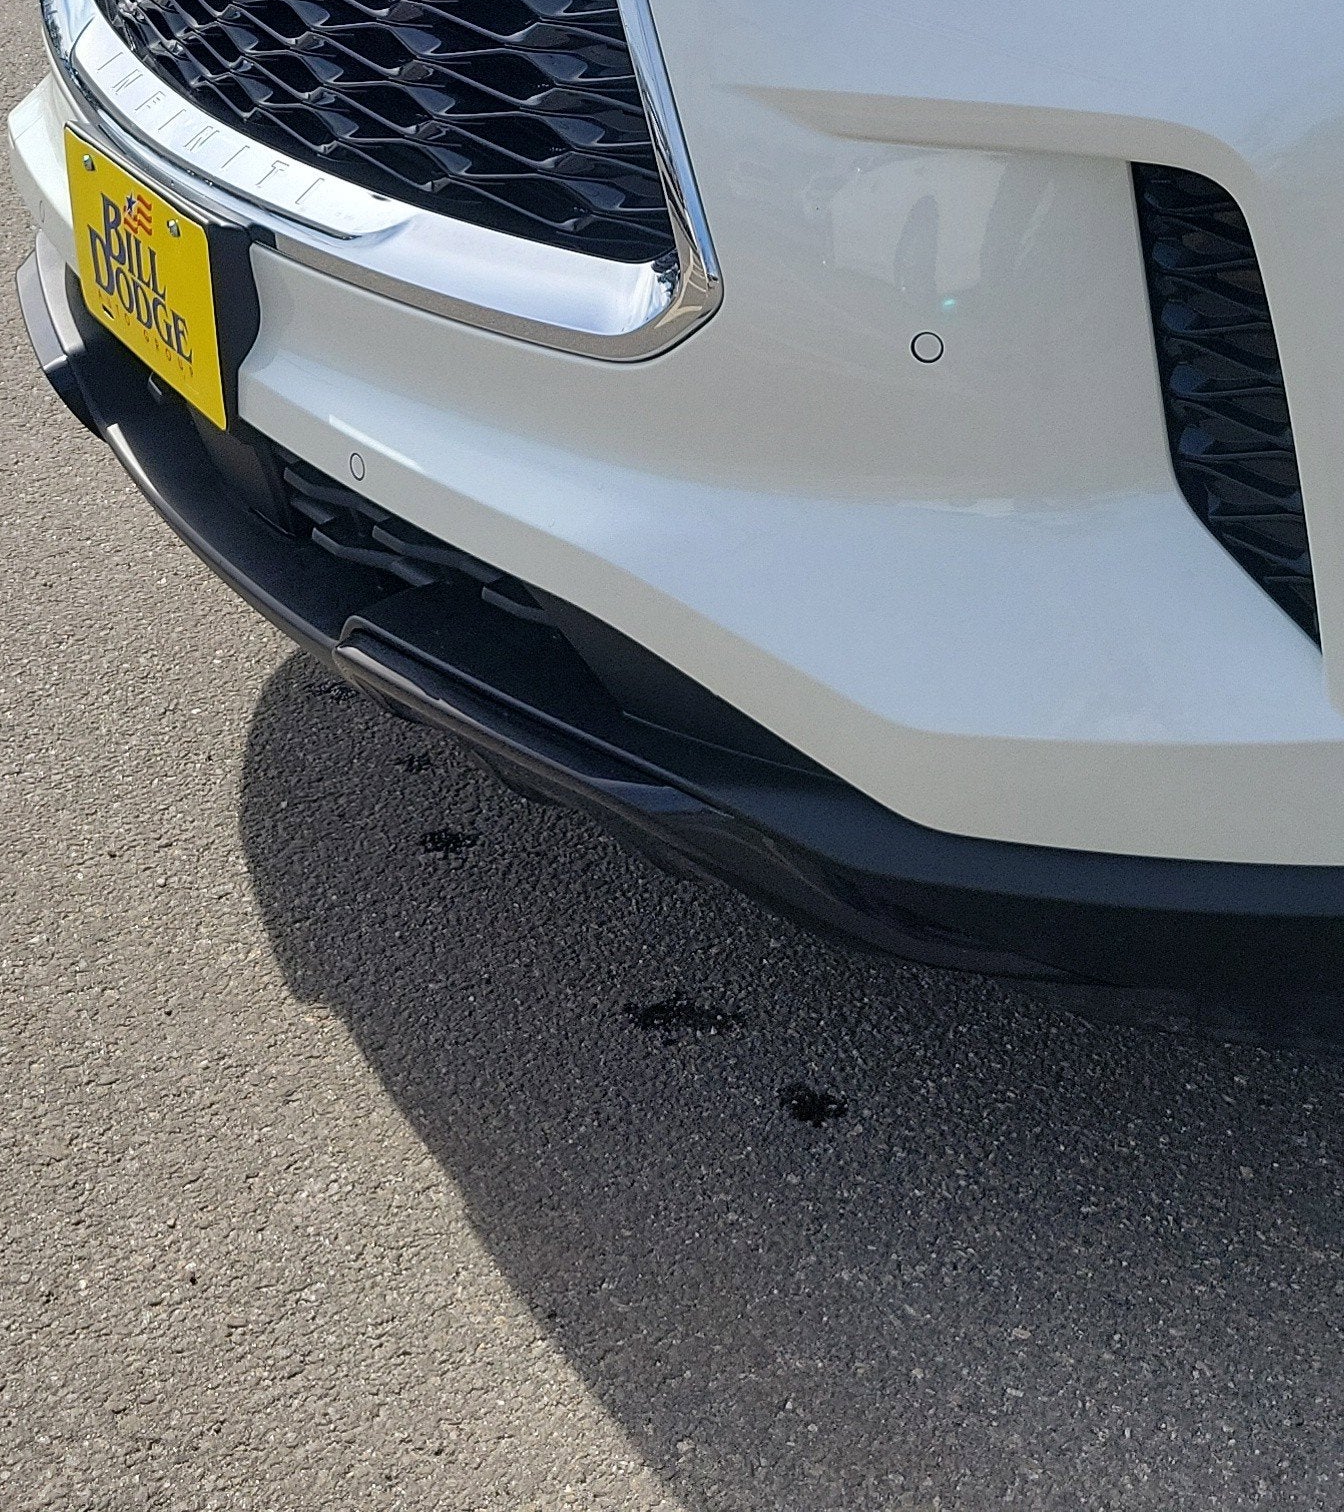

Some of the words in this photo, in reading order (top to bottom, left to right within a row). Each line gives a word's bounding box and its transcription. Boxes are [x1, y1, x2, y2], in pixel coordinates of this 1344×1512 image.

[97, 51, 325, 206] INFINITI
[87, 223, 193, 366] DODGE
[101, 192, 167, 302] BILL
